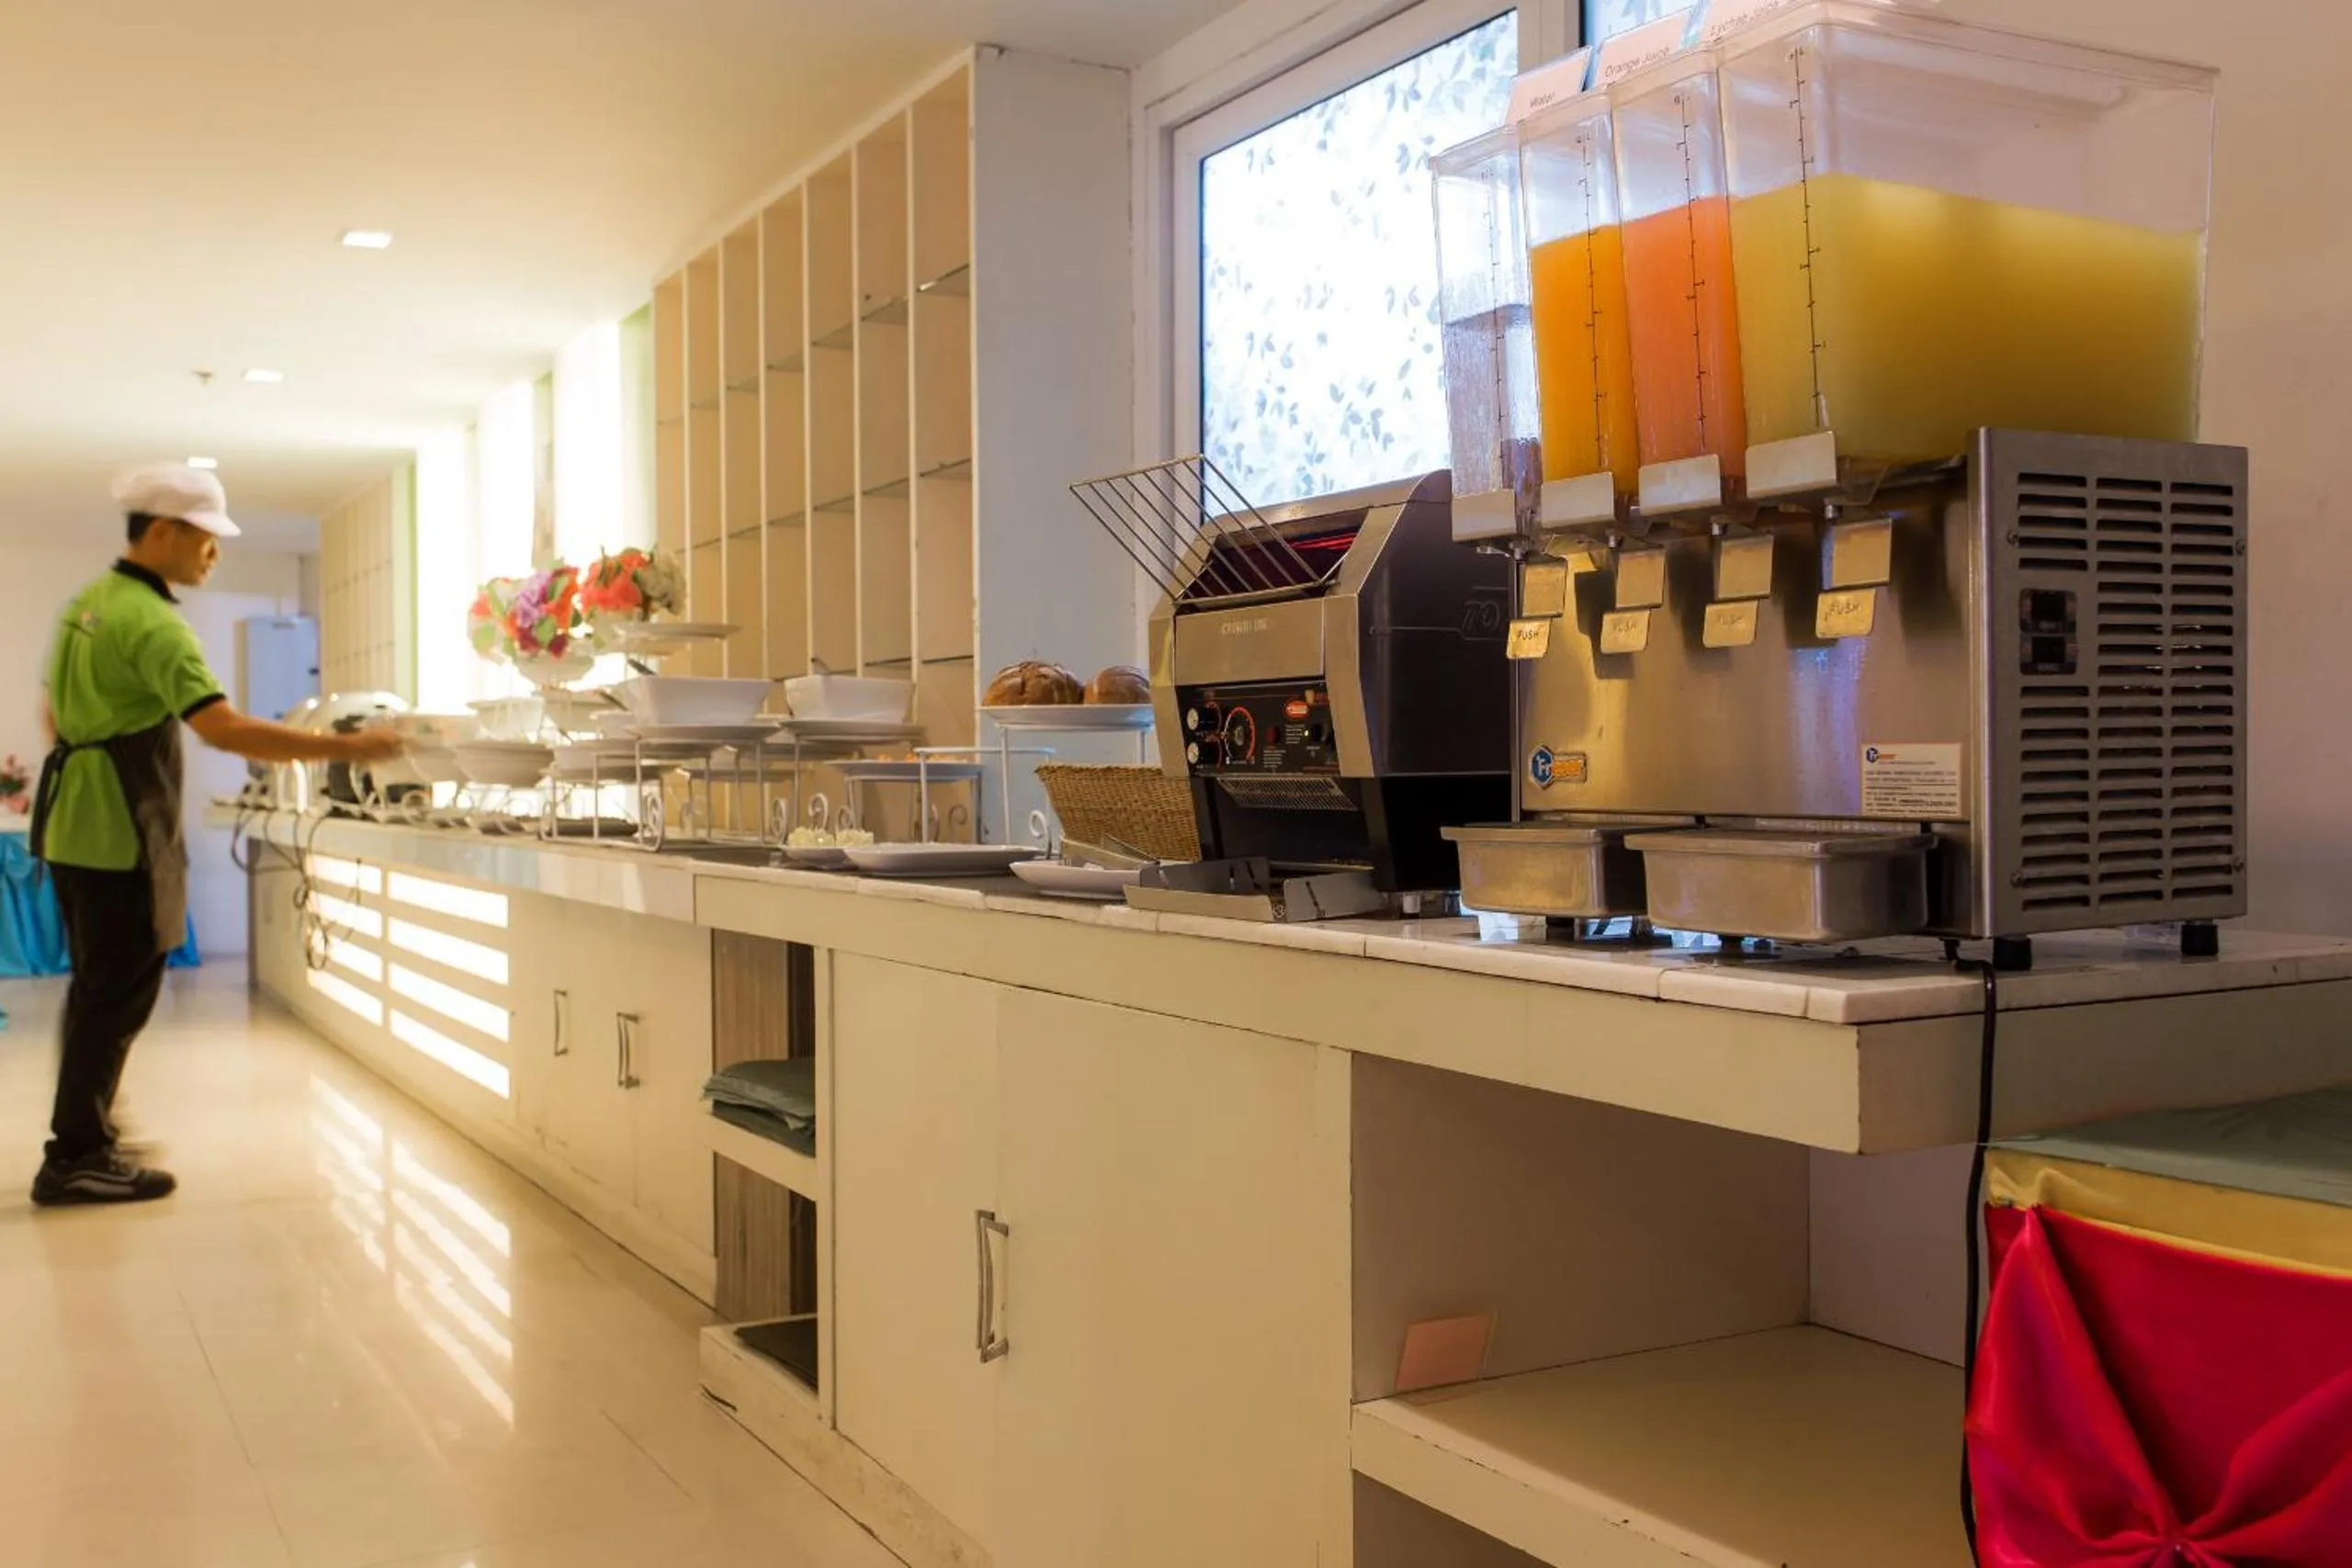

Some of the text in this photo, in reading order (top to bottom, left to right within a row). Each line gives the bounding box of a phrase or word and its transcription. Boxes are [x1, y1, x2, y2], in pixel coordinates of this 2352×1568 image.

[1605, 57, 1641, 78] Orange
[1829, 602, 1860, 616] PUSH
[1517, 628, 1540, 641] PUSH
